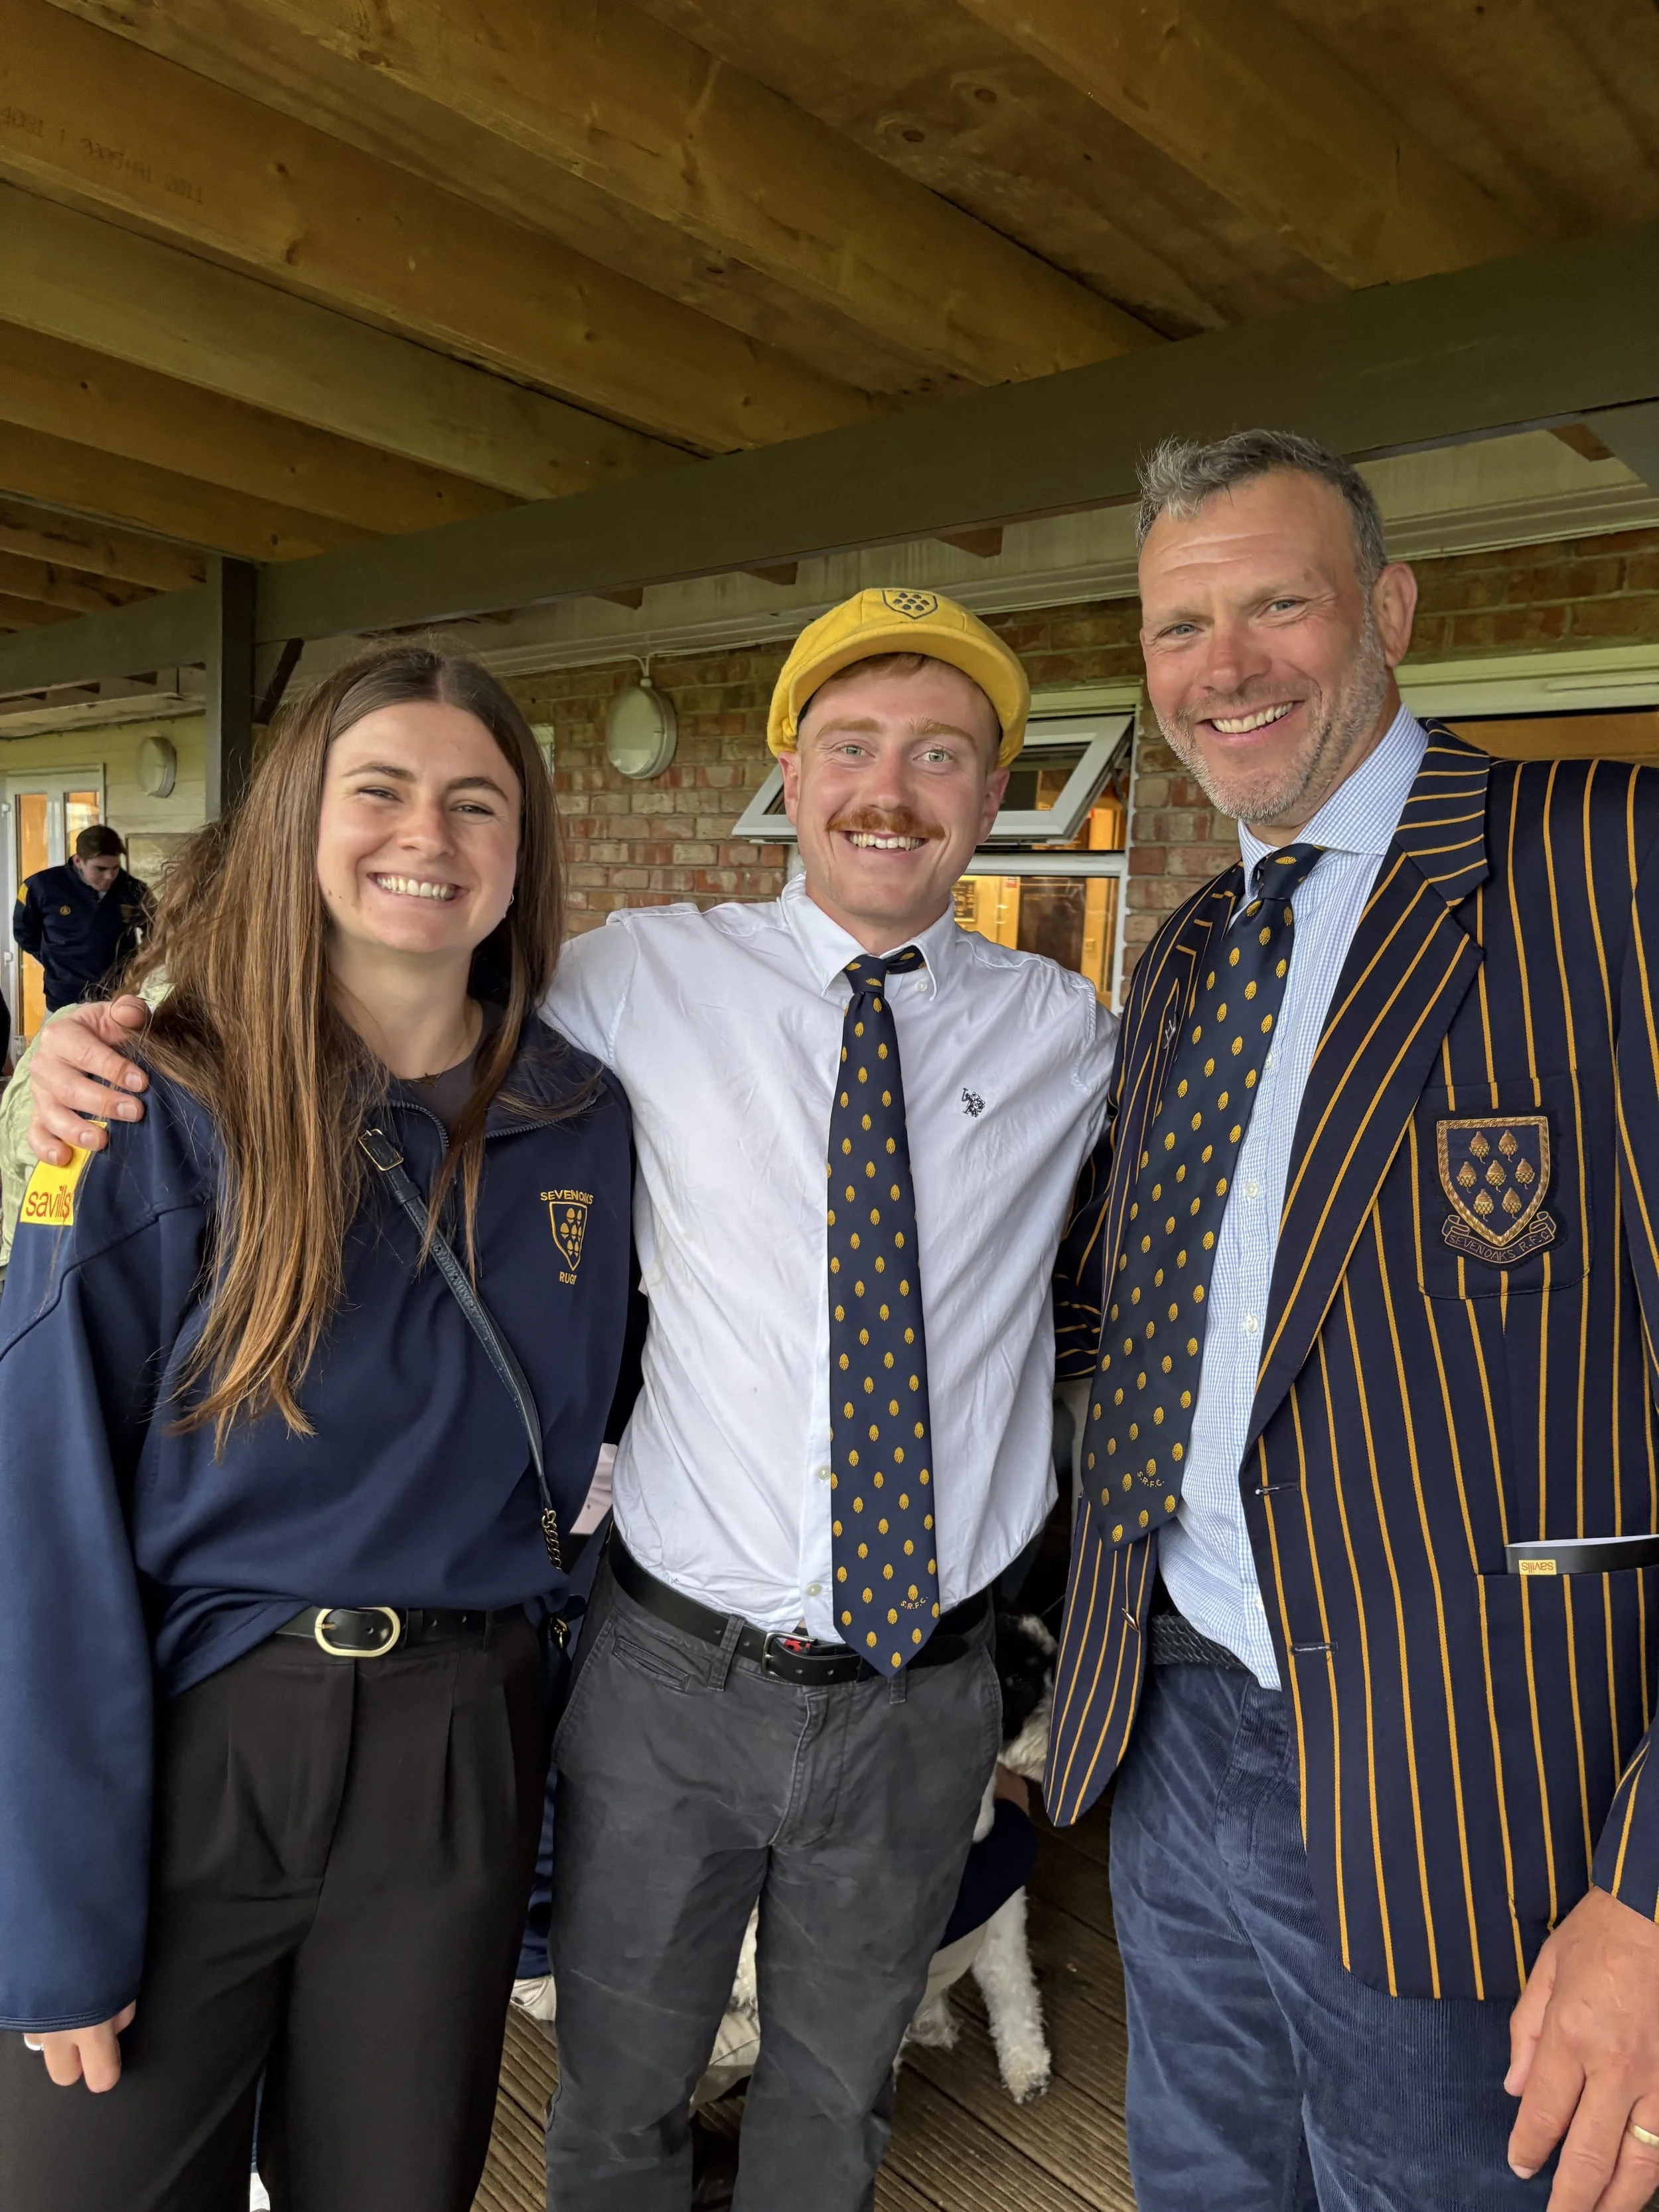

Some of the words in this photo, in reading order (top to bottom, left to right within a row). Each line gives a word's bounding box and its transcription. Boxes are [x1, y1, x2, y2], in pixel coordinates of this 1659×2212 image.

[25, 1185, 72, 1219] savills
[540, 1189, 594, 1205] SEVENOAKS
[1449, 1235, 1516, 1262] SEVENOAKS
[1521, 1562, 1554, 1574] savills
[900, 1596, 928, 1609] S.R.F.C.
